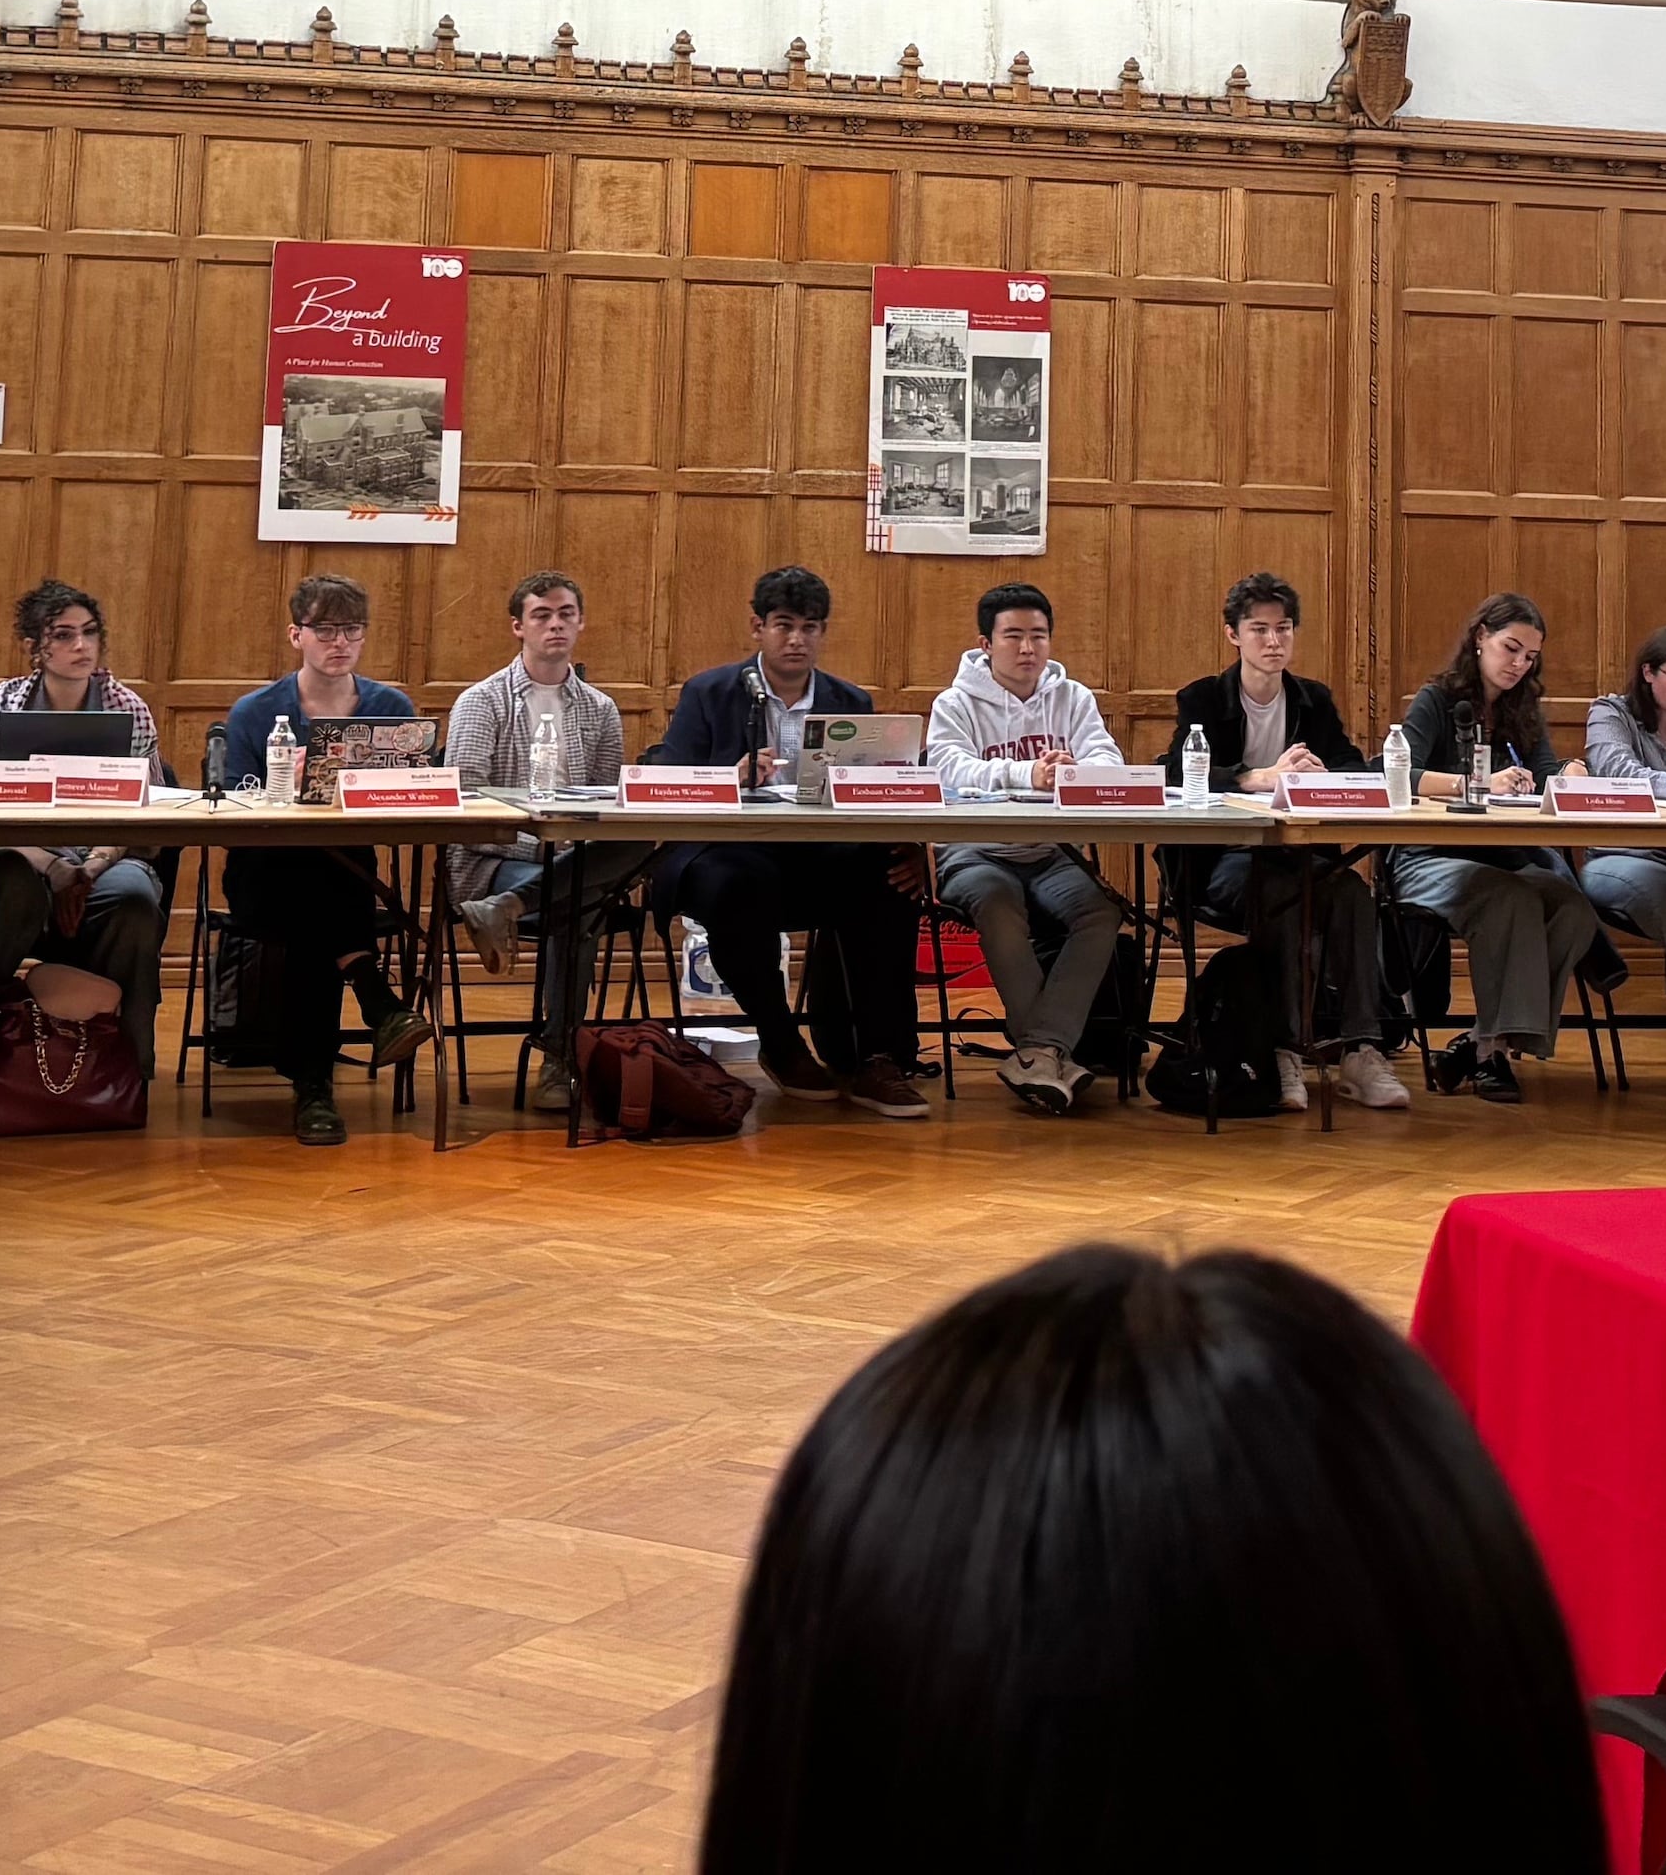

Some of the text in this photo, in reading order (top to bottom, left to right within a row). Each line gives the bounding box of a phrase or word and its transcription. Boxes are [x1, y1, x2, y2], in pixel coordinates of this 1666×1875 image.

[274, 276, 391, 333] Beyond
[352, 330, 443, 354] a building
